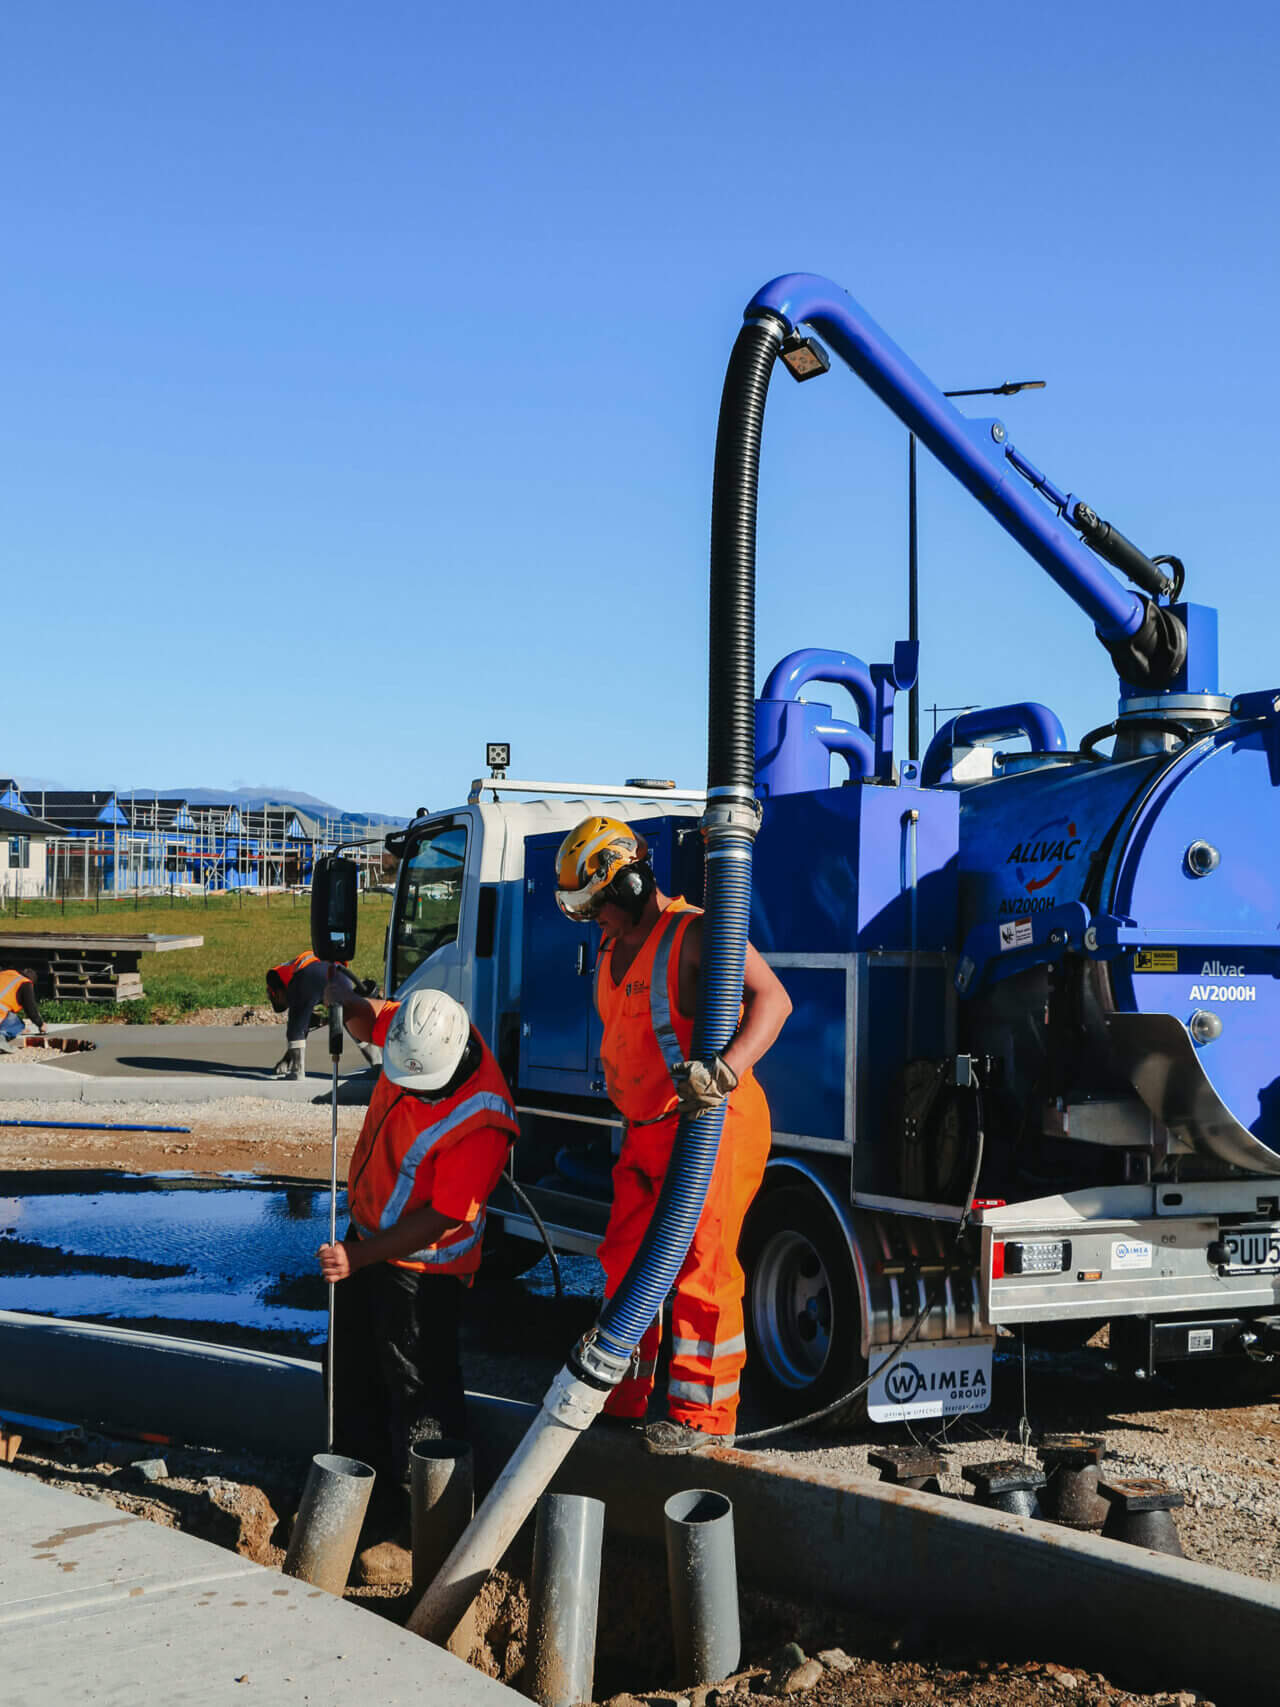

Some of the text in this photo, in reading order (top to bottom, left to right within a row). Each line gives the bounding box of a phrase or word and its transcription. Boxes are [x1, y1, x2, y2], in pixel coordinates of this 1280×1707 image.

[1006, 839, 1081, 864] ALLVAC
[999, 896, 1056, 915] AV2000H
[1200, 960, 1246, 977] Allvac
[1189, 984, 1257, 1002] AV2000H
[1117, 1245, 1149, 1257] WAIMEA
[889, 1367, 987, 1395] WAIMEA
[950, 1388, 987, 1400] GROUP
